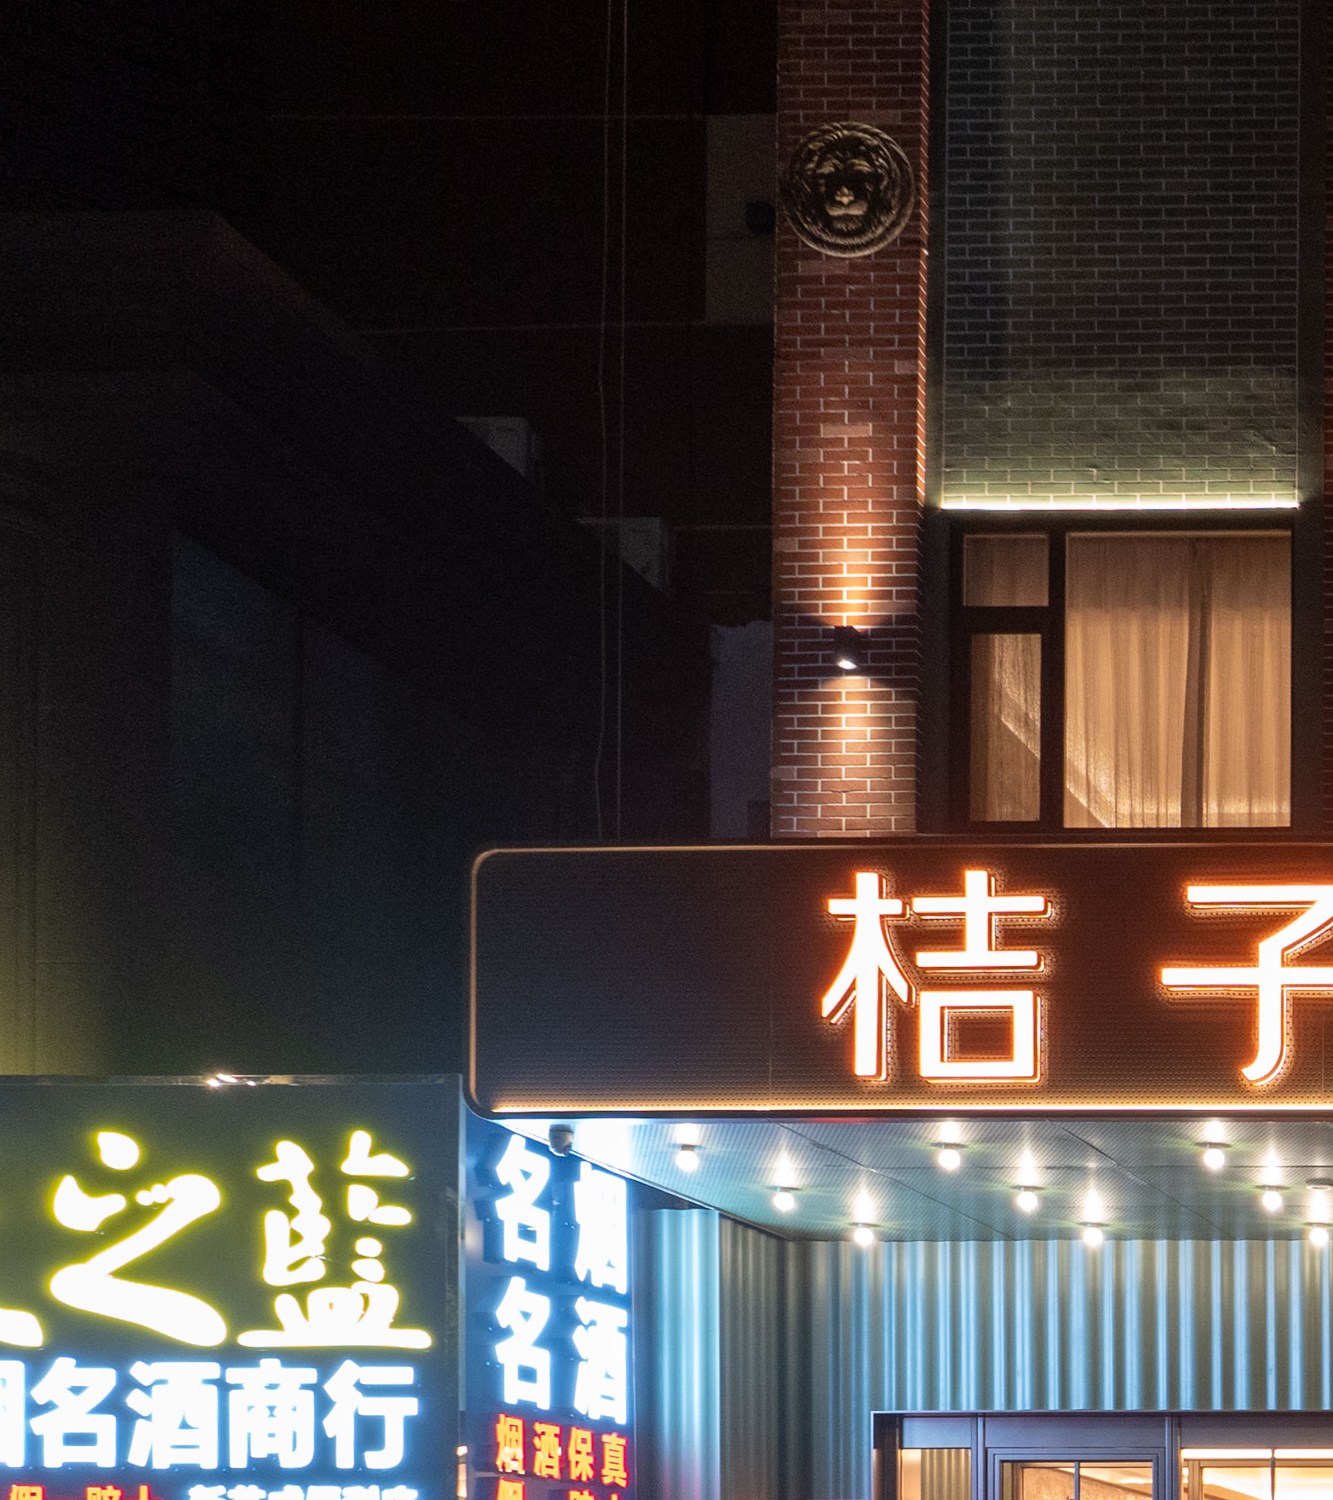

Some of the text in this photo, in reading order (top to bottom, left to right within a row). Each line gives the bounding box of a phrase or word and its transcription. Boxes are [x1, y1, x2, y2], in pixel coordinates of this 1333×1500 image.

[496, 1134, 628, 1295] 名烟
[496, 1276, 628, 1425] 名酒
[496, 1413, 628, 1487] 烟酒保真
